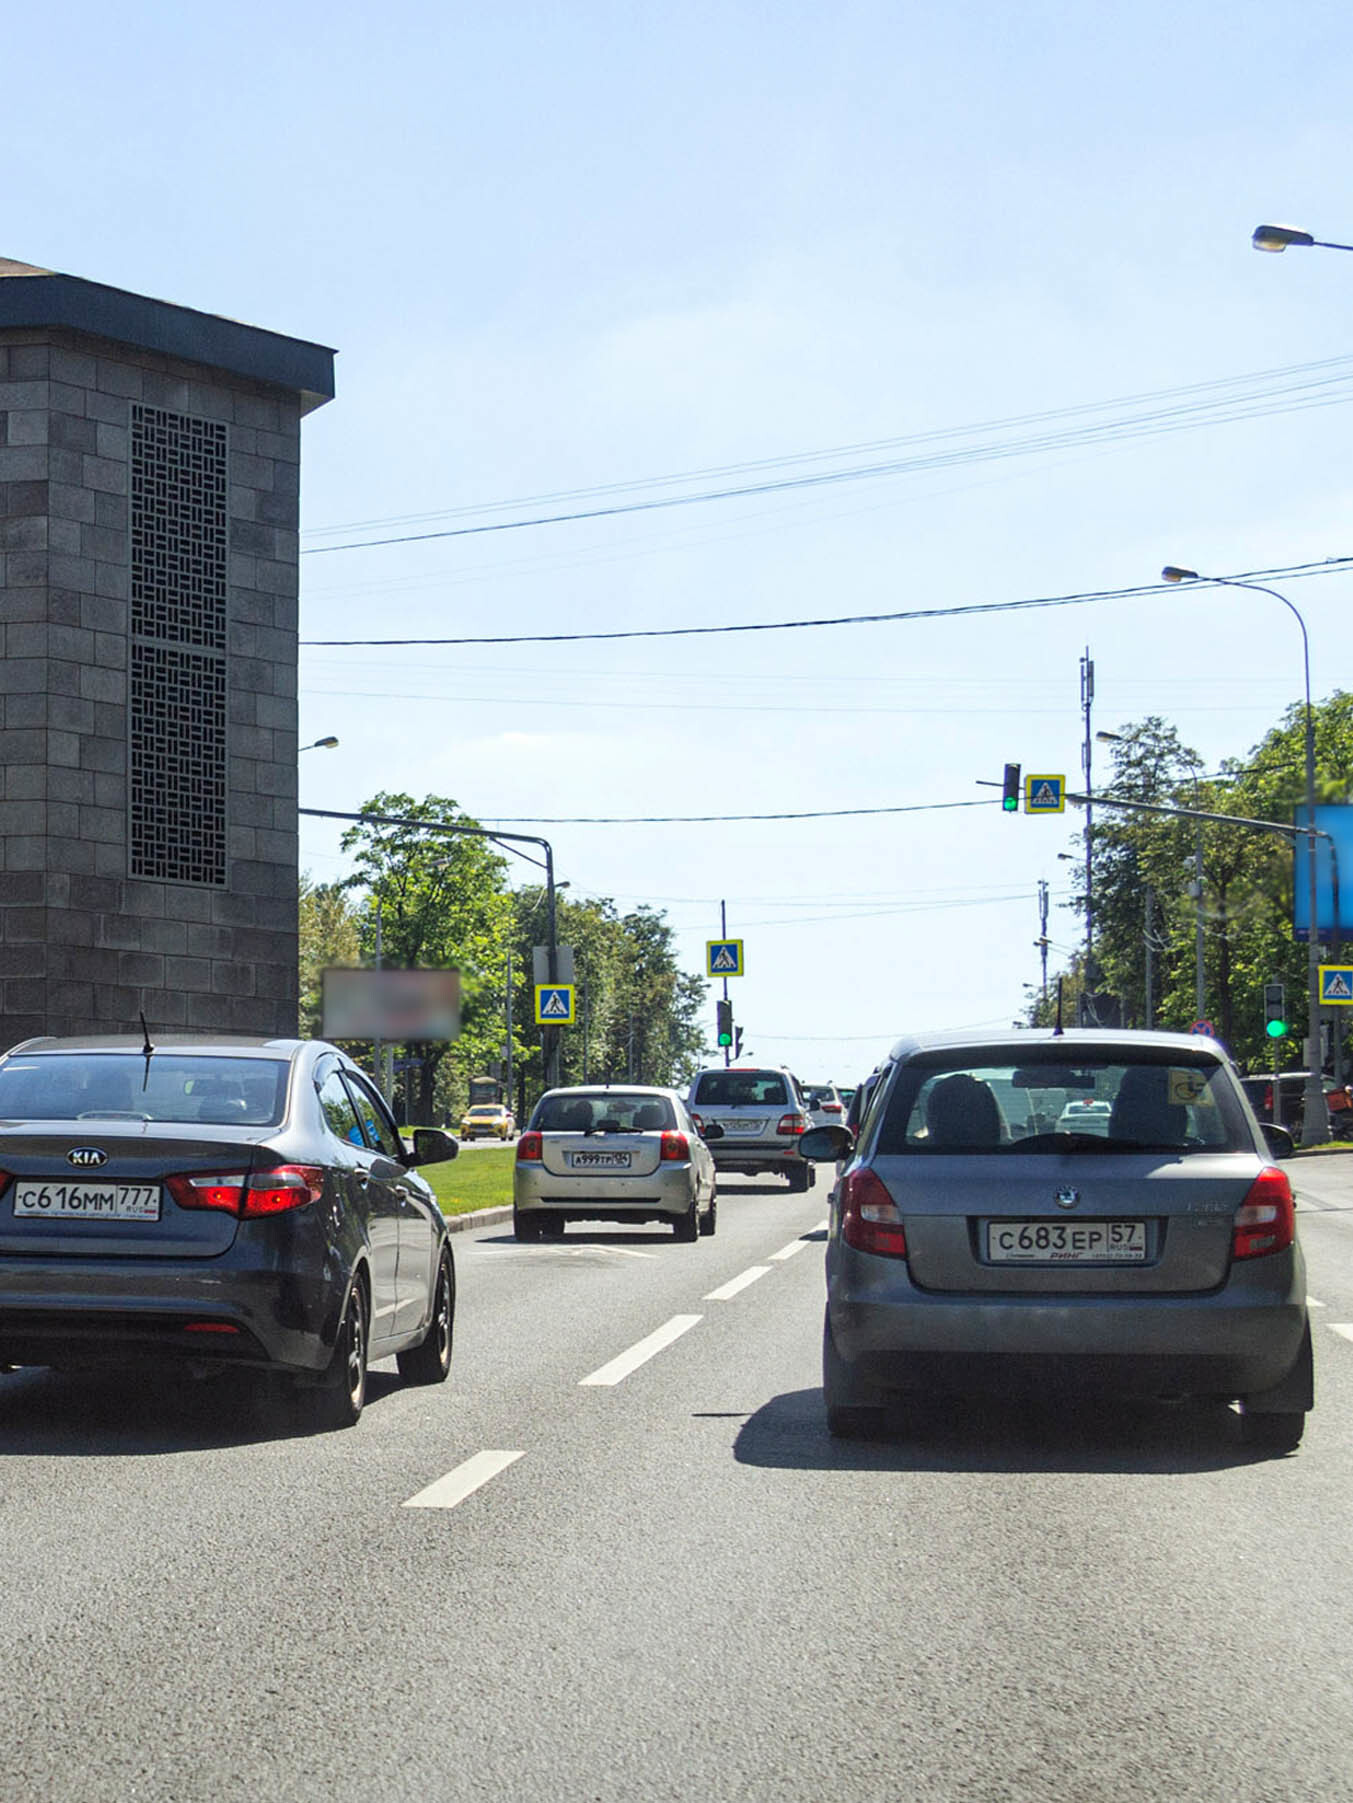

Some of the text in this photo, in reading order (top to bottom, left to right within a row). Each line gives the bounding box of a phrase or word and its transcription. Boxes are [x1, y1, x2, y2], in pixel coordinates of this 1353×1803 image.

[72, 1151, 101, 1164] KIA
[119, 1187, 153, 1206] 777
[1111, 1224, 1136, 1243] 57
